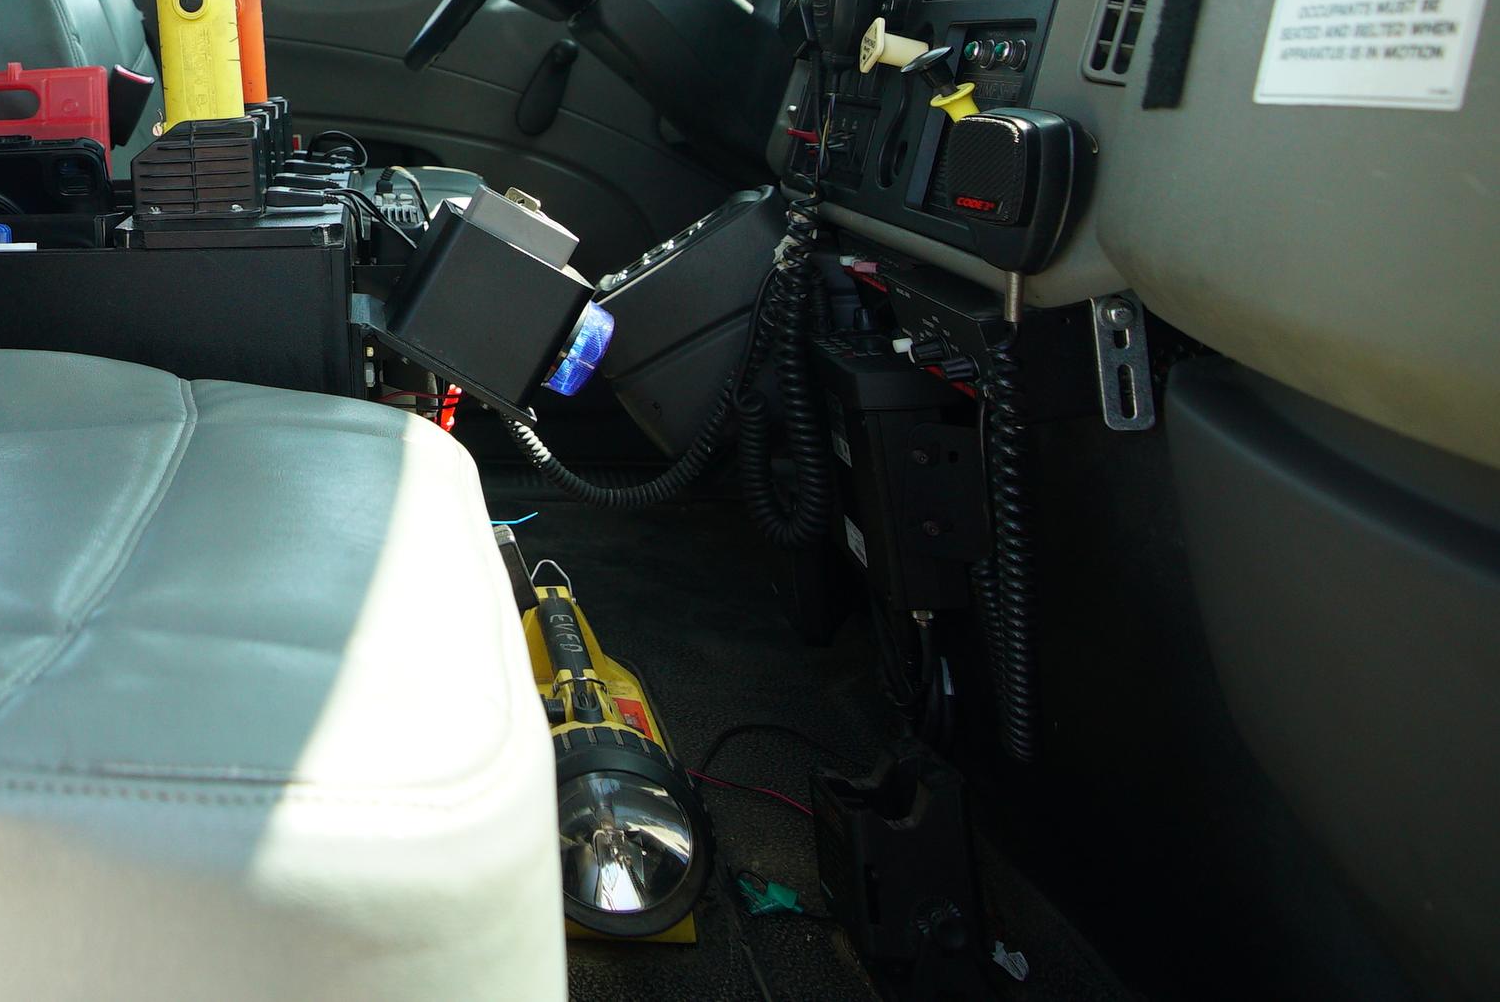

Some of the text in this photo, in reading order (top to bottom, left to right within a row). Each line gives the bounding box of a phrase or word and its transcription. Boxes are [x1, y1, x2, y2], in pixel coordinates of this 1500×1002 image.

[1298, 0, 1371, 19] OCCUPANTS
[1280, 20, 1459, 41] SEATED AND BELTED WHEN
[1279, 44, 1445, 61] APPARATUS IS IN MOTION
